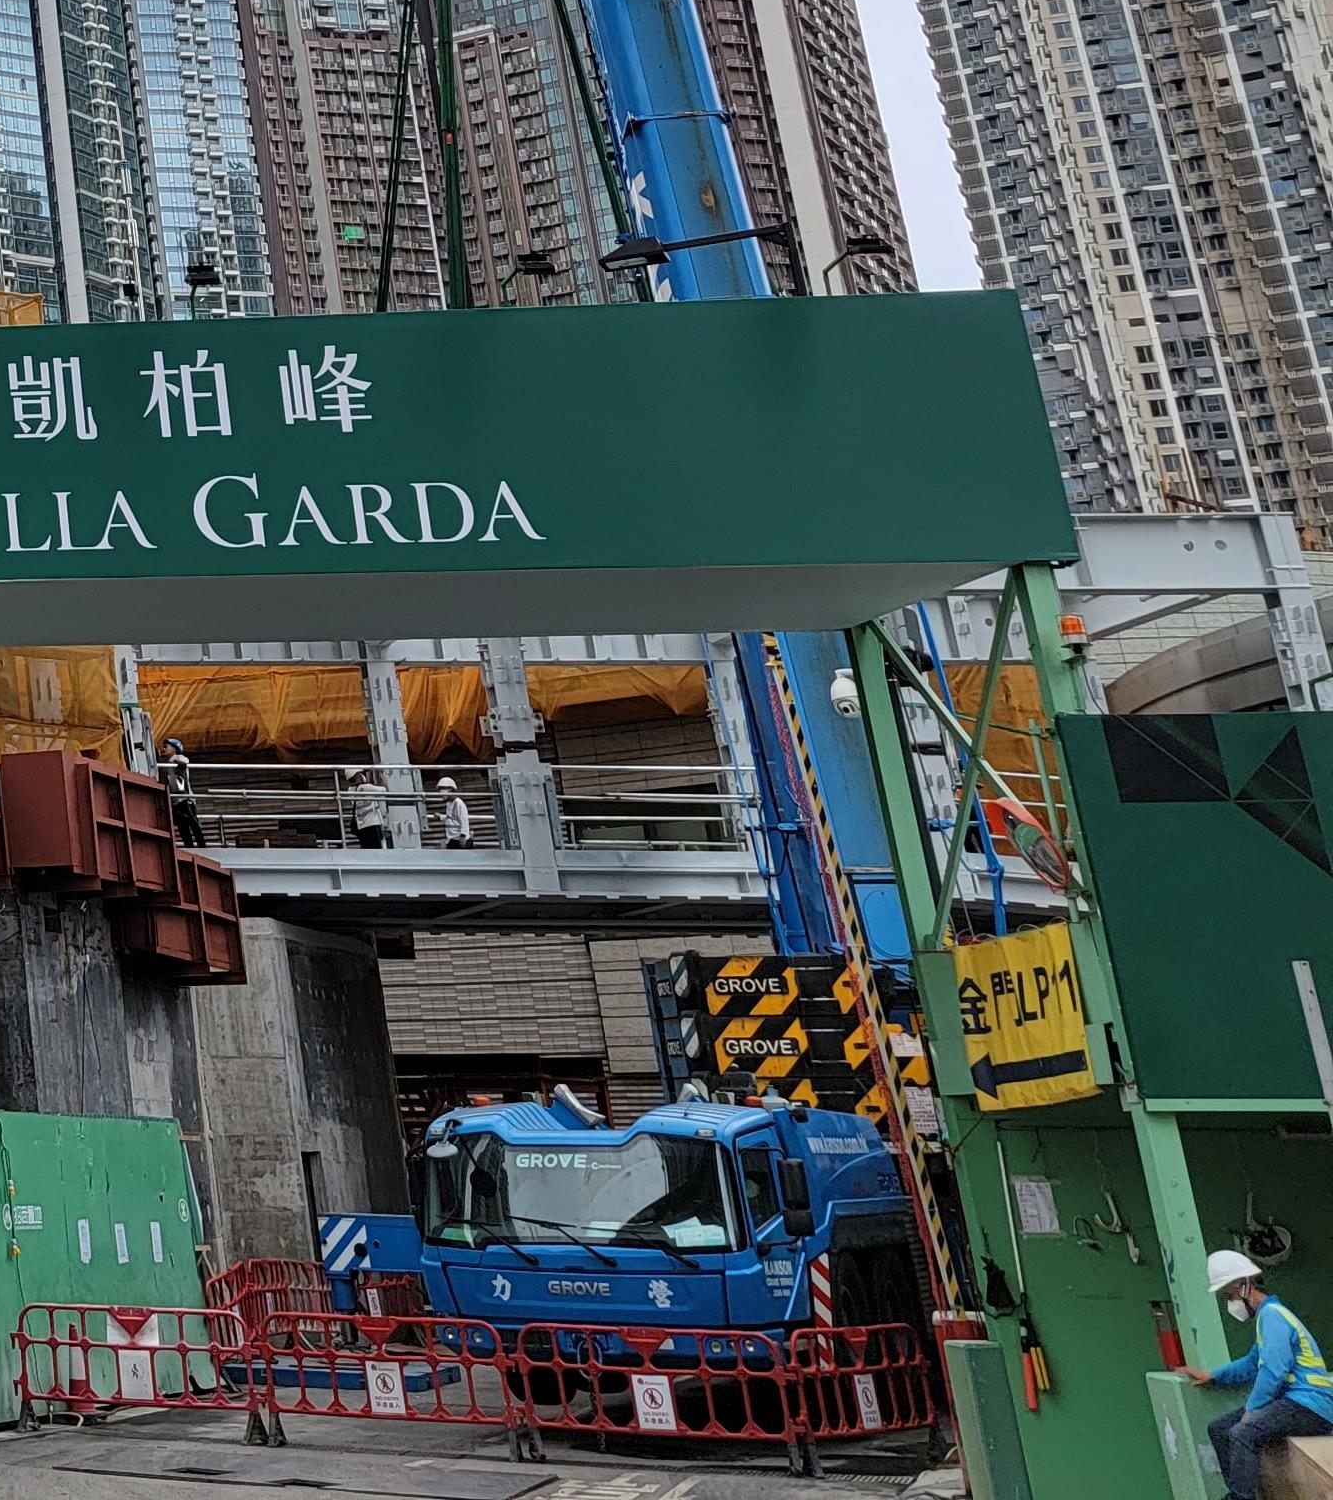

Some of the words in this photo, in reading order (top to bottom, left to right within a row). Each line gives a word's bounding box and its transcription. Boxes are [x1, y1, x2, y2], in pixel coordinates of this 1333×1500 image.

[8, 344, 373, 442] 凱柏峰
[193, 473, 547, 549] GARDA
[715, 978, 782, 993] GROVE
[725, 1039, 794, 1054] GROVE
[515, 1153, 588, 1169] GROVE
[491, 1274, 512, 1301] 力
[548, 1280, 612, 1297] GROVE
